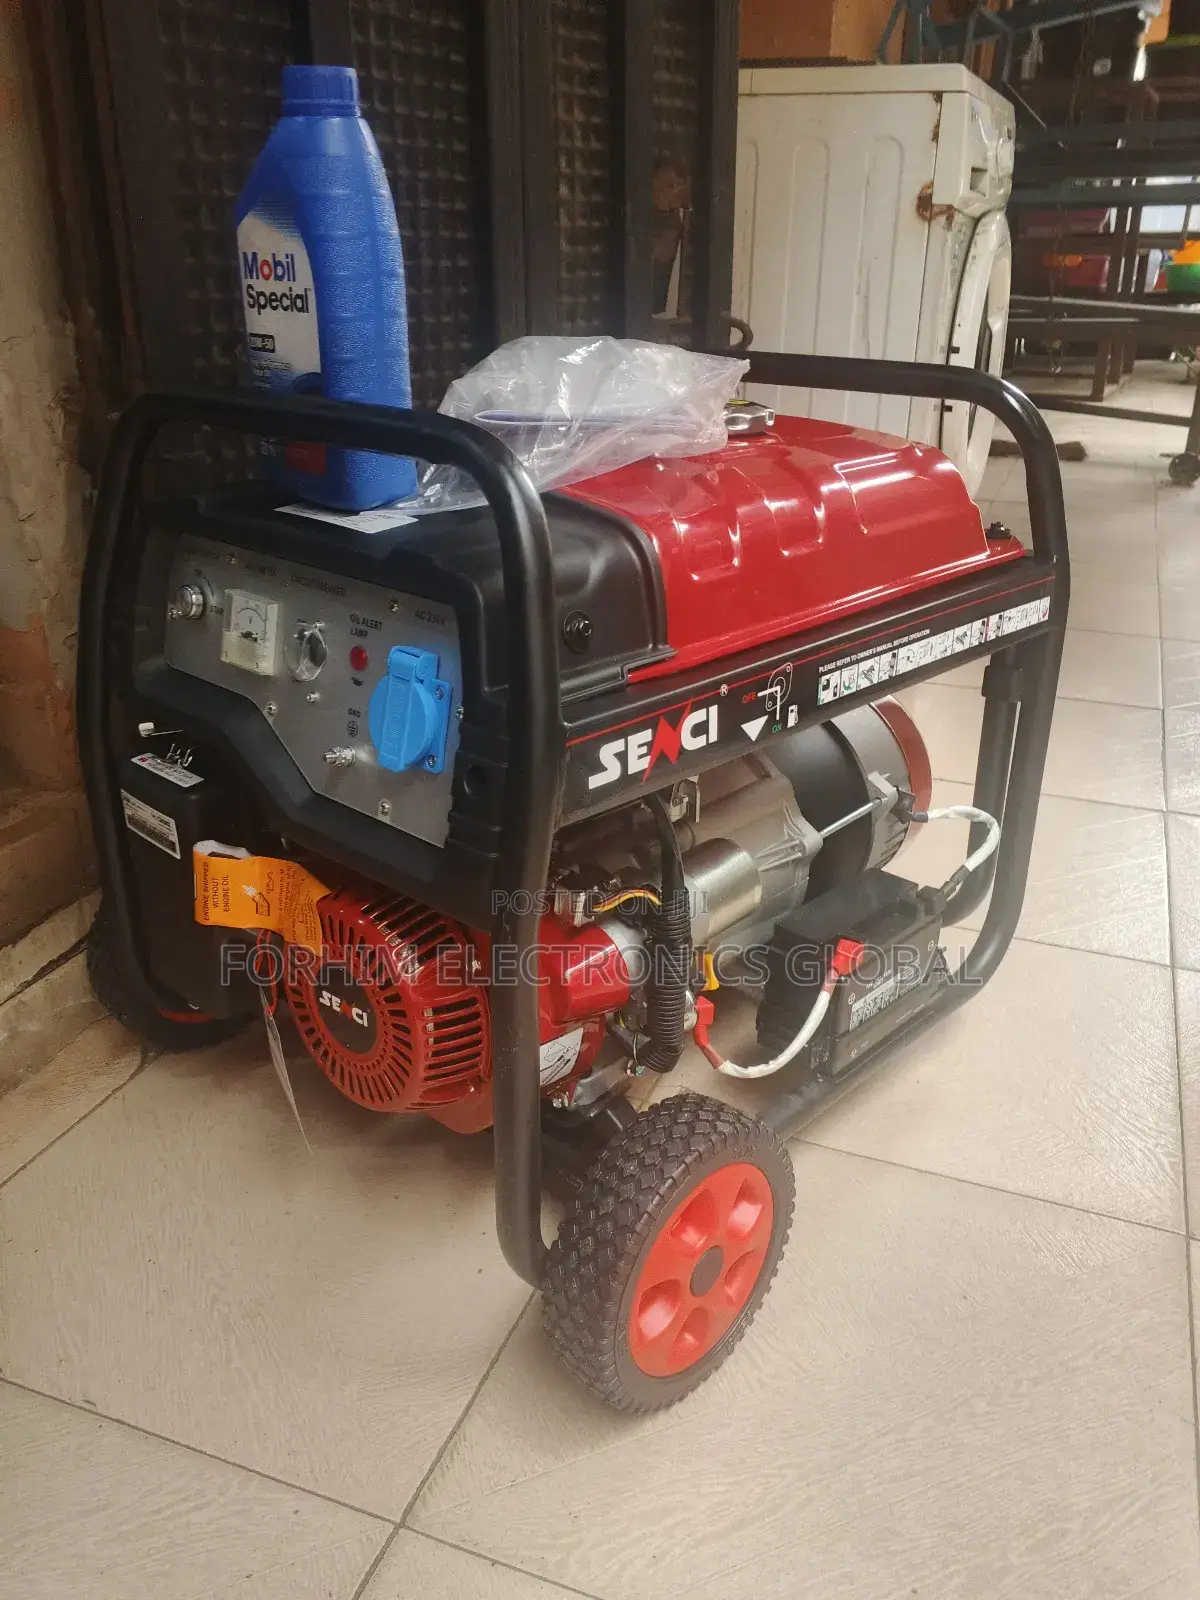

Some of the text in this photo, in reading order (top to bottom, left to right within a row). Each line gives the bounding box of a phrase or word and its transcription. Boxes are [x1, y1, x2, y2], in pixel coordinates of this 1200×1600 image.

[243, 251, 296, 282] Mobil
[246, 283, 310, 315] Special
[350, 627, 368, 638] LAMP
[361, 616, 383, 631] ALERT
[818, 662, 836, 673] PLEASE
[836, 656, 851, 667] REFER
[856, 647, 877, 660] OWNER'S
[876, 641, 893, 653] MANUAL
[908, 628, 931, 641] OPERATION
[588, 698, 719, 790] SENCI
[211, 876, 219, 909] WITHOUT
[221, 874, 231, 912] ENGINE OIL
